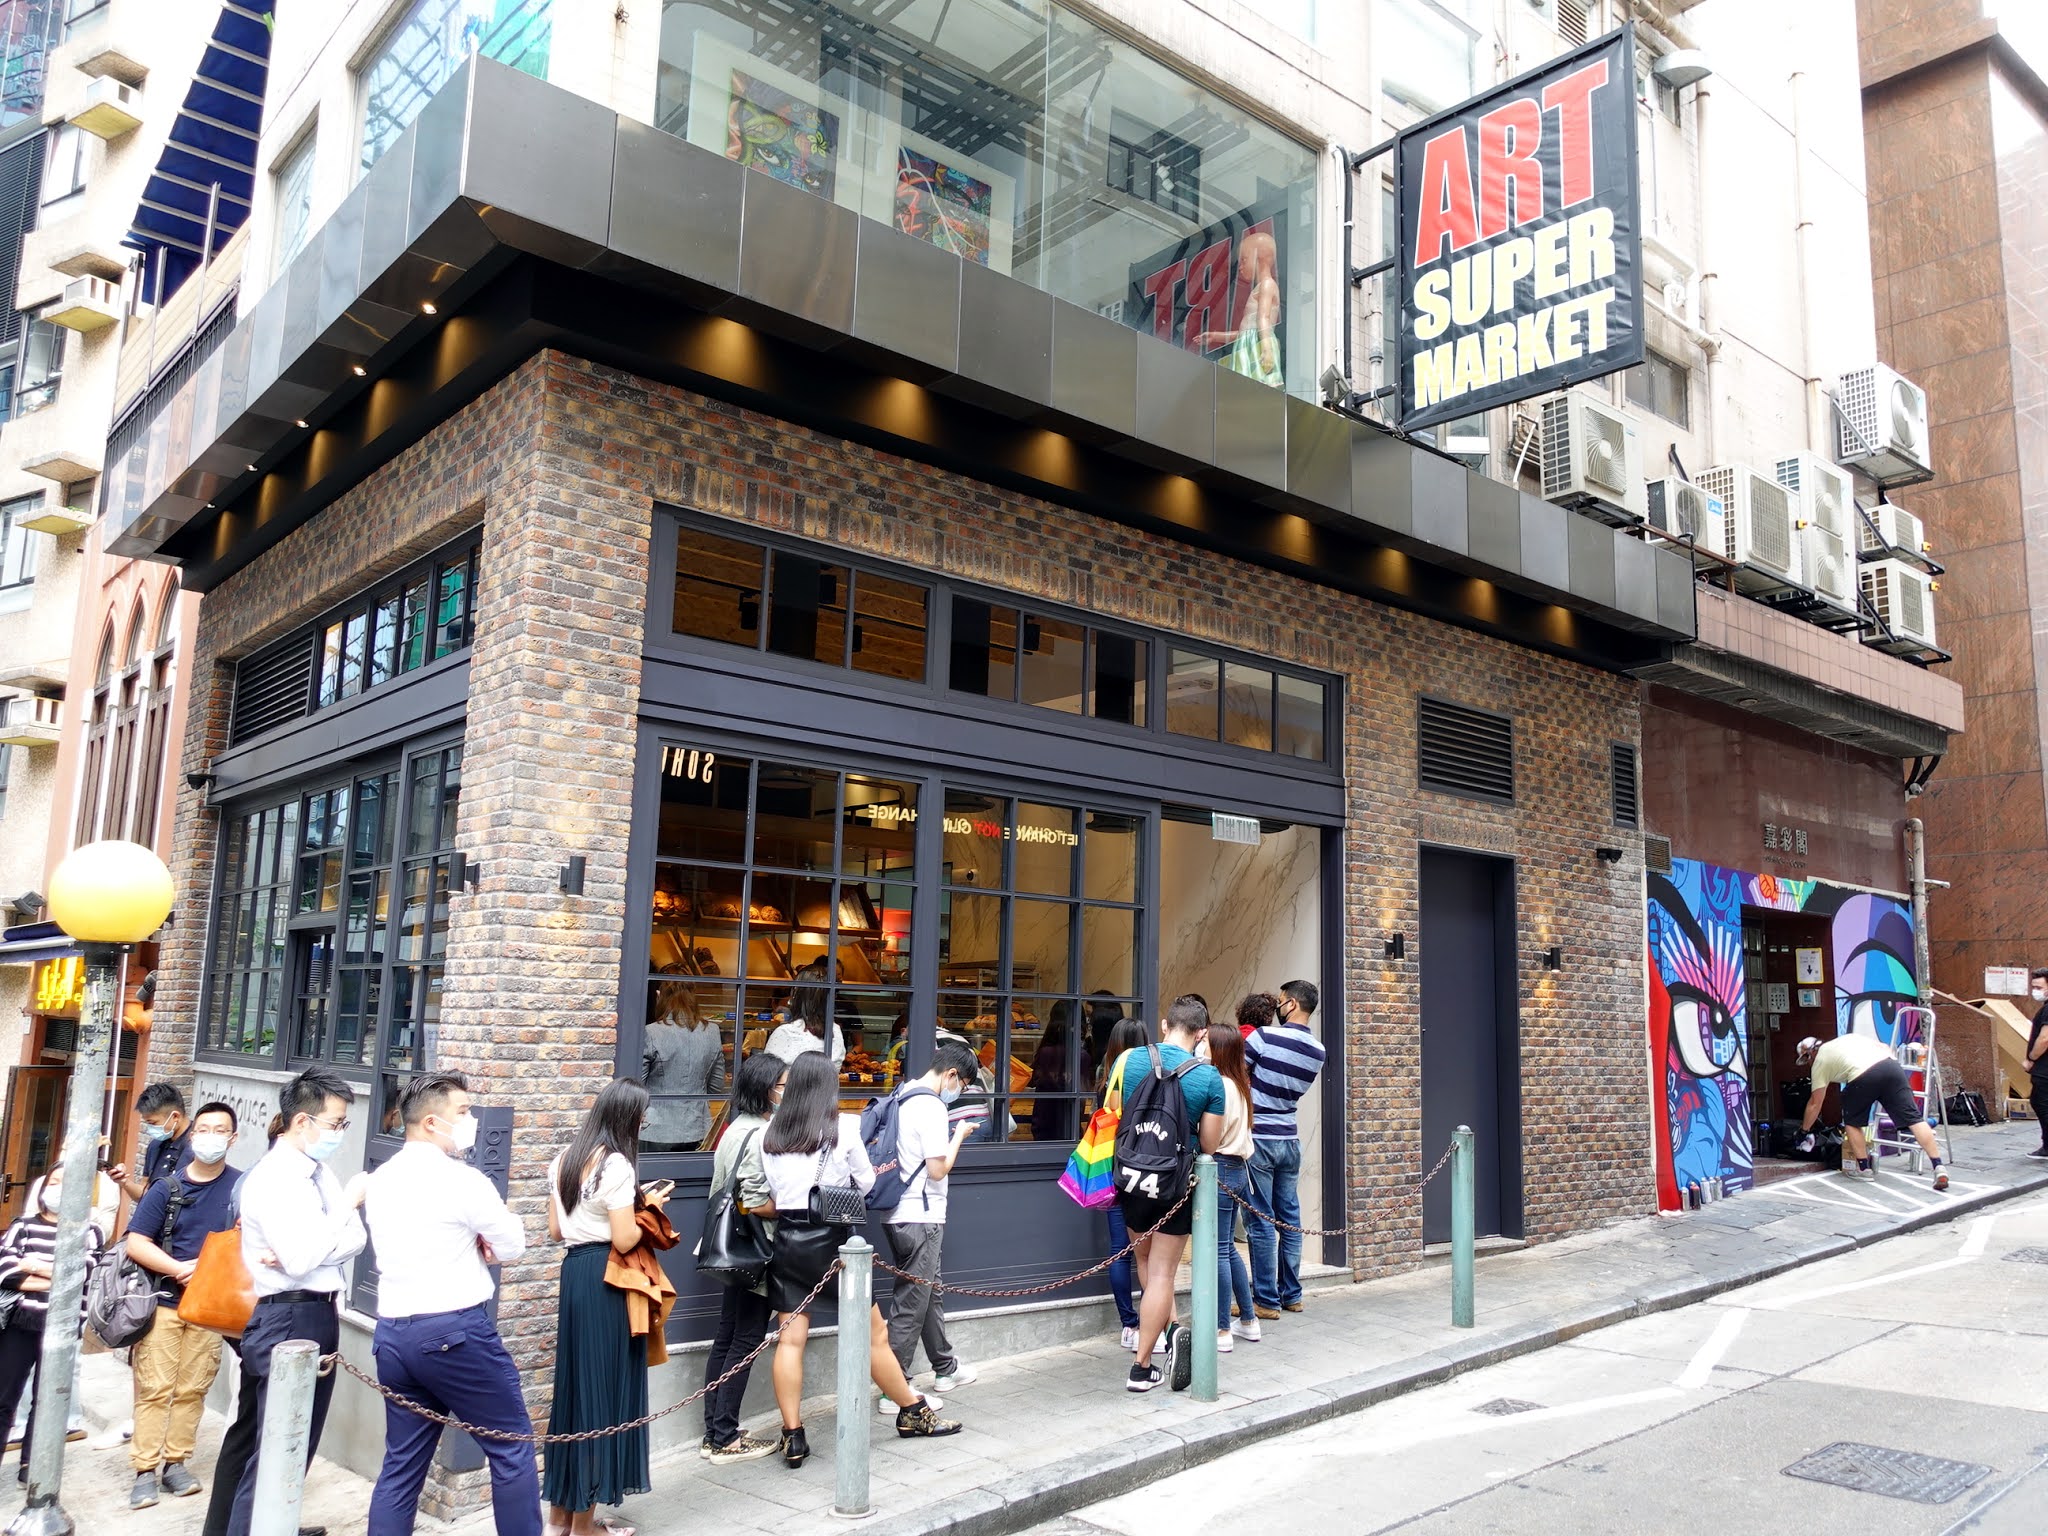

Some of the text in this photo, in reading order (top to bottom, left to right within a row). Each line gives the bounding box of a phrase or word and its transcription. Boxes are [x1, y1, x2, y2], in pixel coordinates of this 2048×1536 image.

[1414, 58, 1609, 269] ART
[1413, 207, 1616, 341] SUPER
[1413, 288, 1616, 411] MARKET
[1764, 822, 1808, 856] 嘉彩閣
[1121, 1166, 1160, 1199] 74
